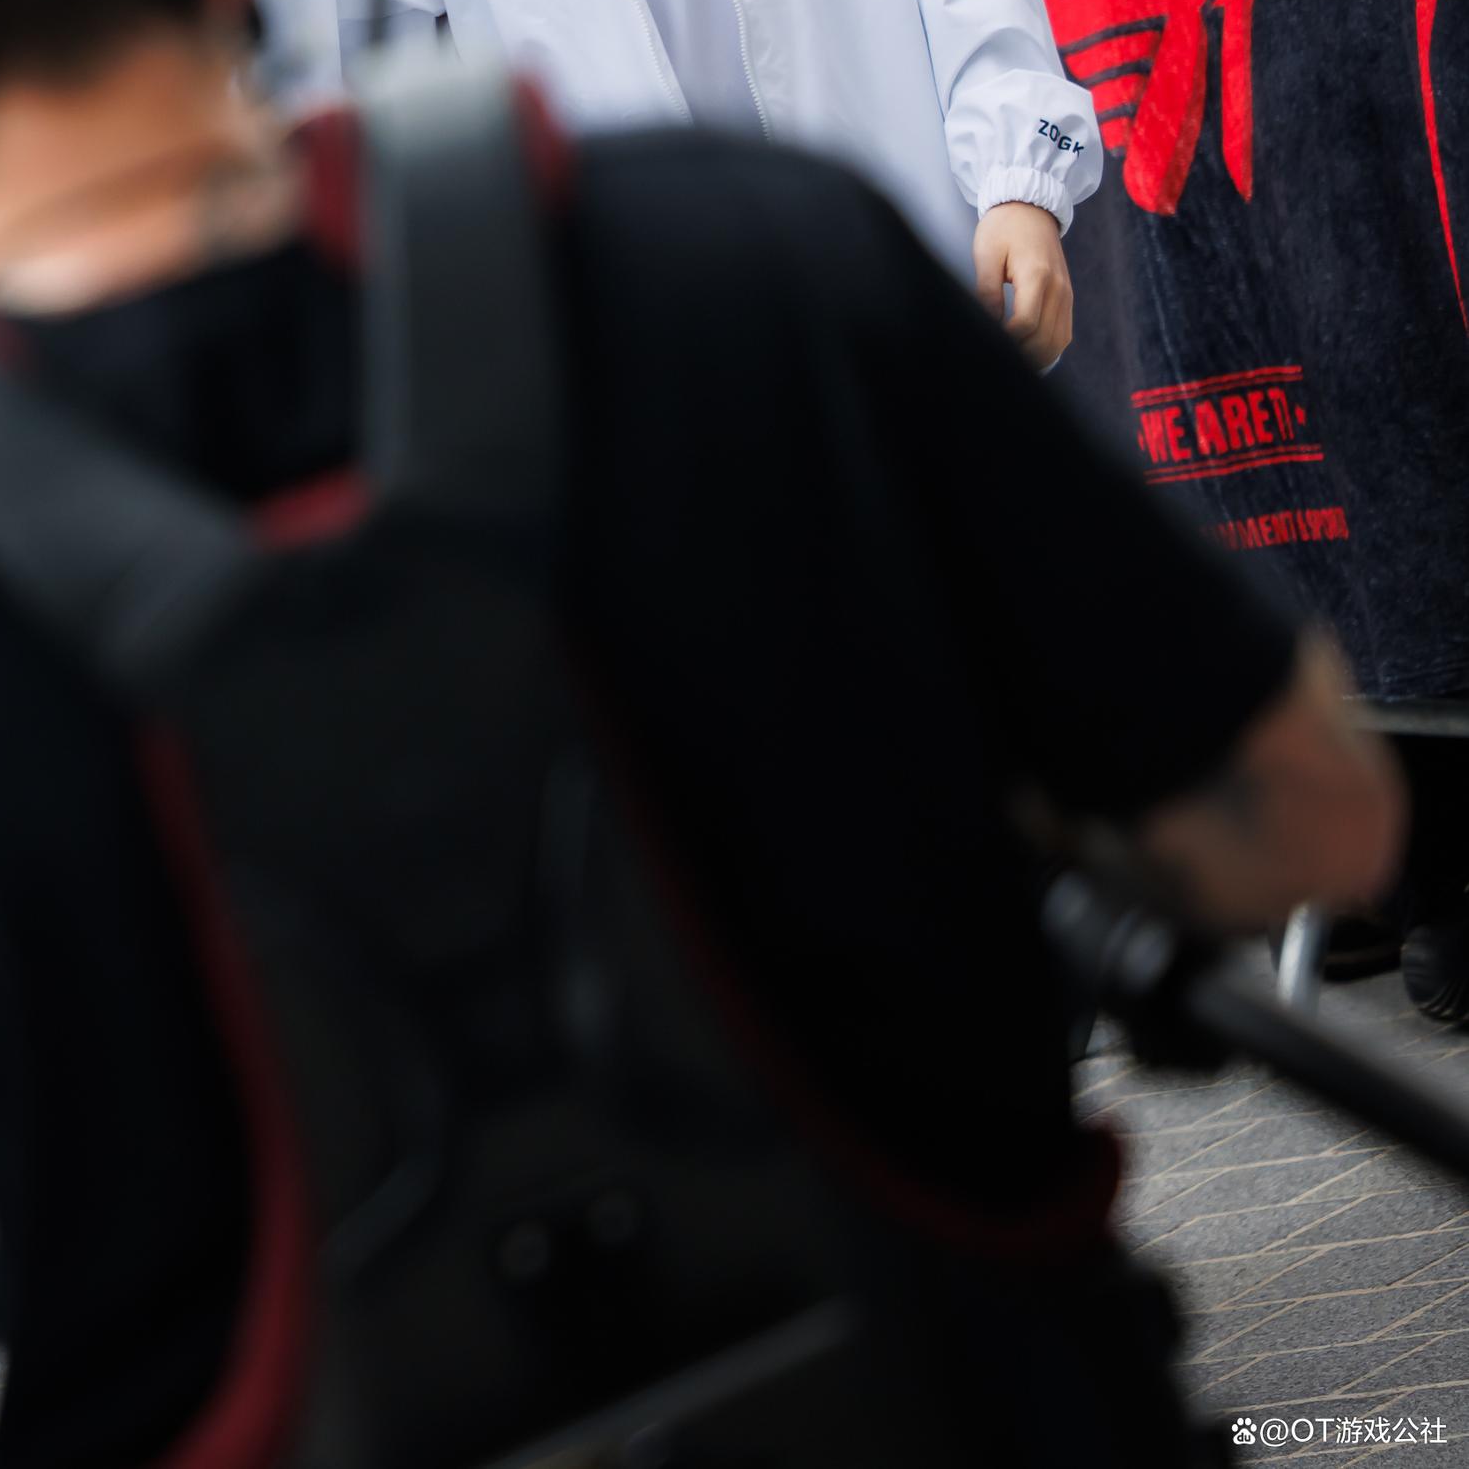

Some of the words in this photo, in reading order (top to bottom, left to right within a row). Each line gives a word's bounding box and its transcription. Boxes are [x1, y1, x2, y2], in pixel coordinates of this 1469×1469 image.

[1037, 118, 1085, 159] ZOGK
[1139, 405, 1192, 463] WE
[1194, 390, 1274, 456] ARE
